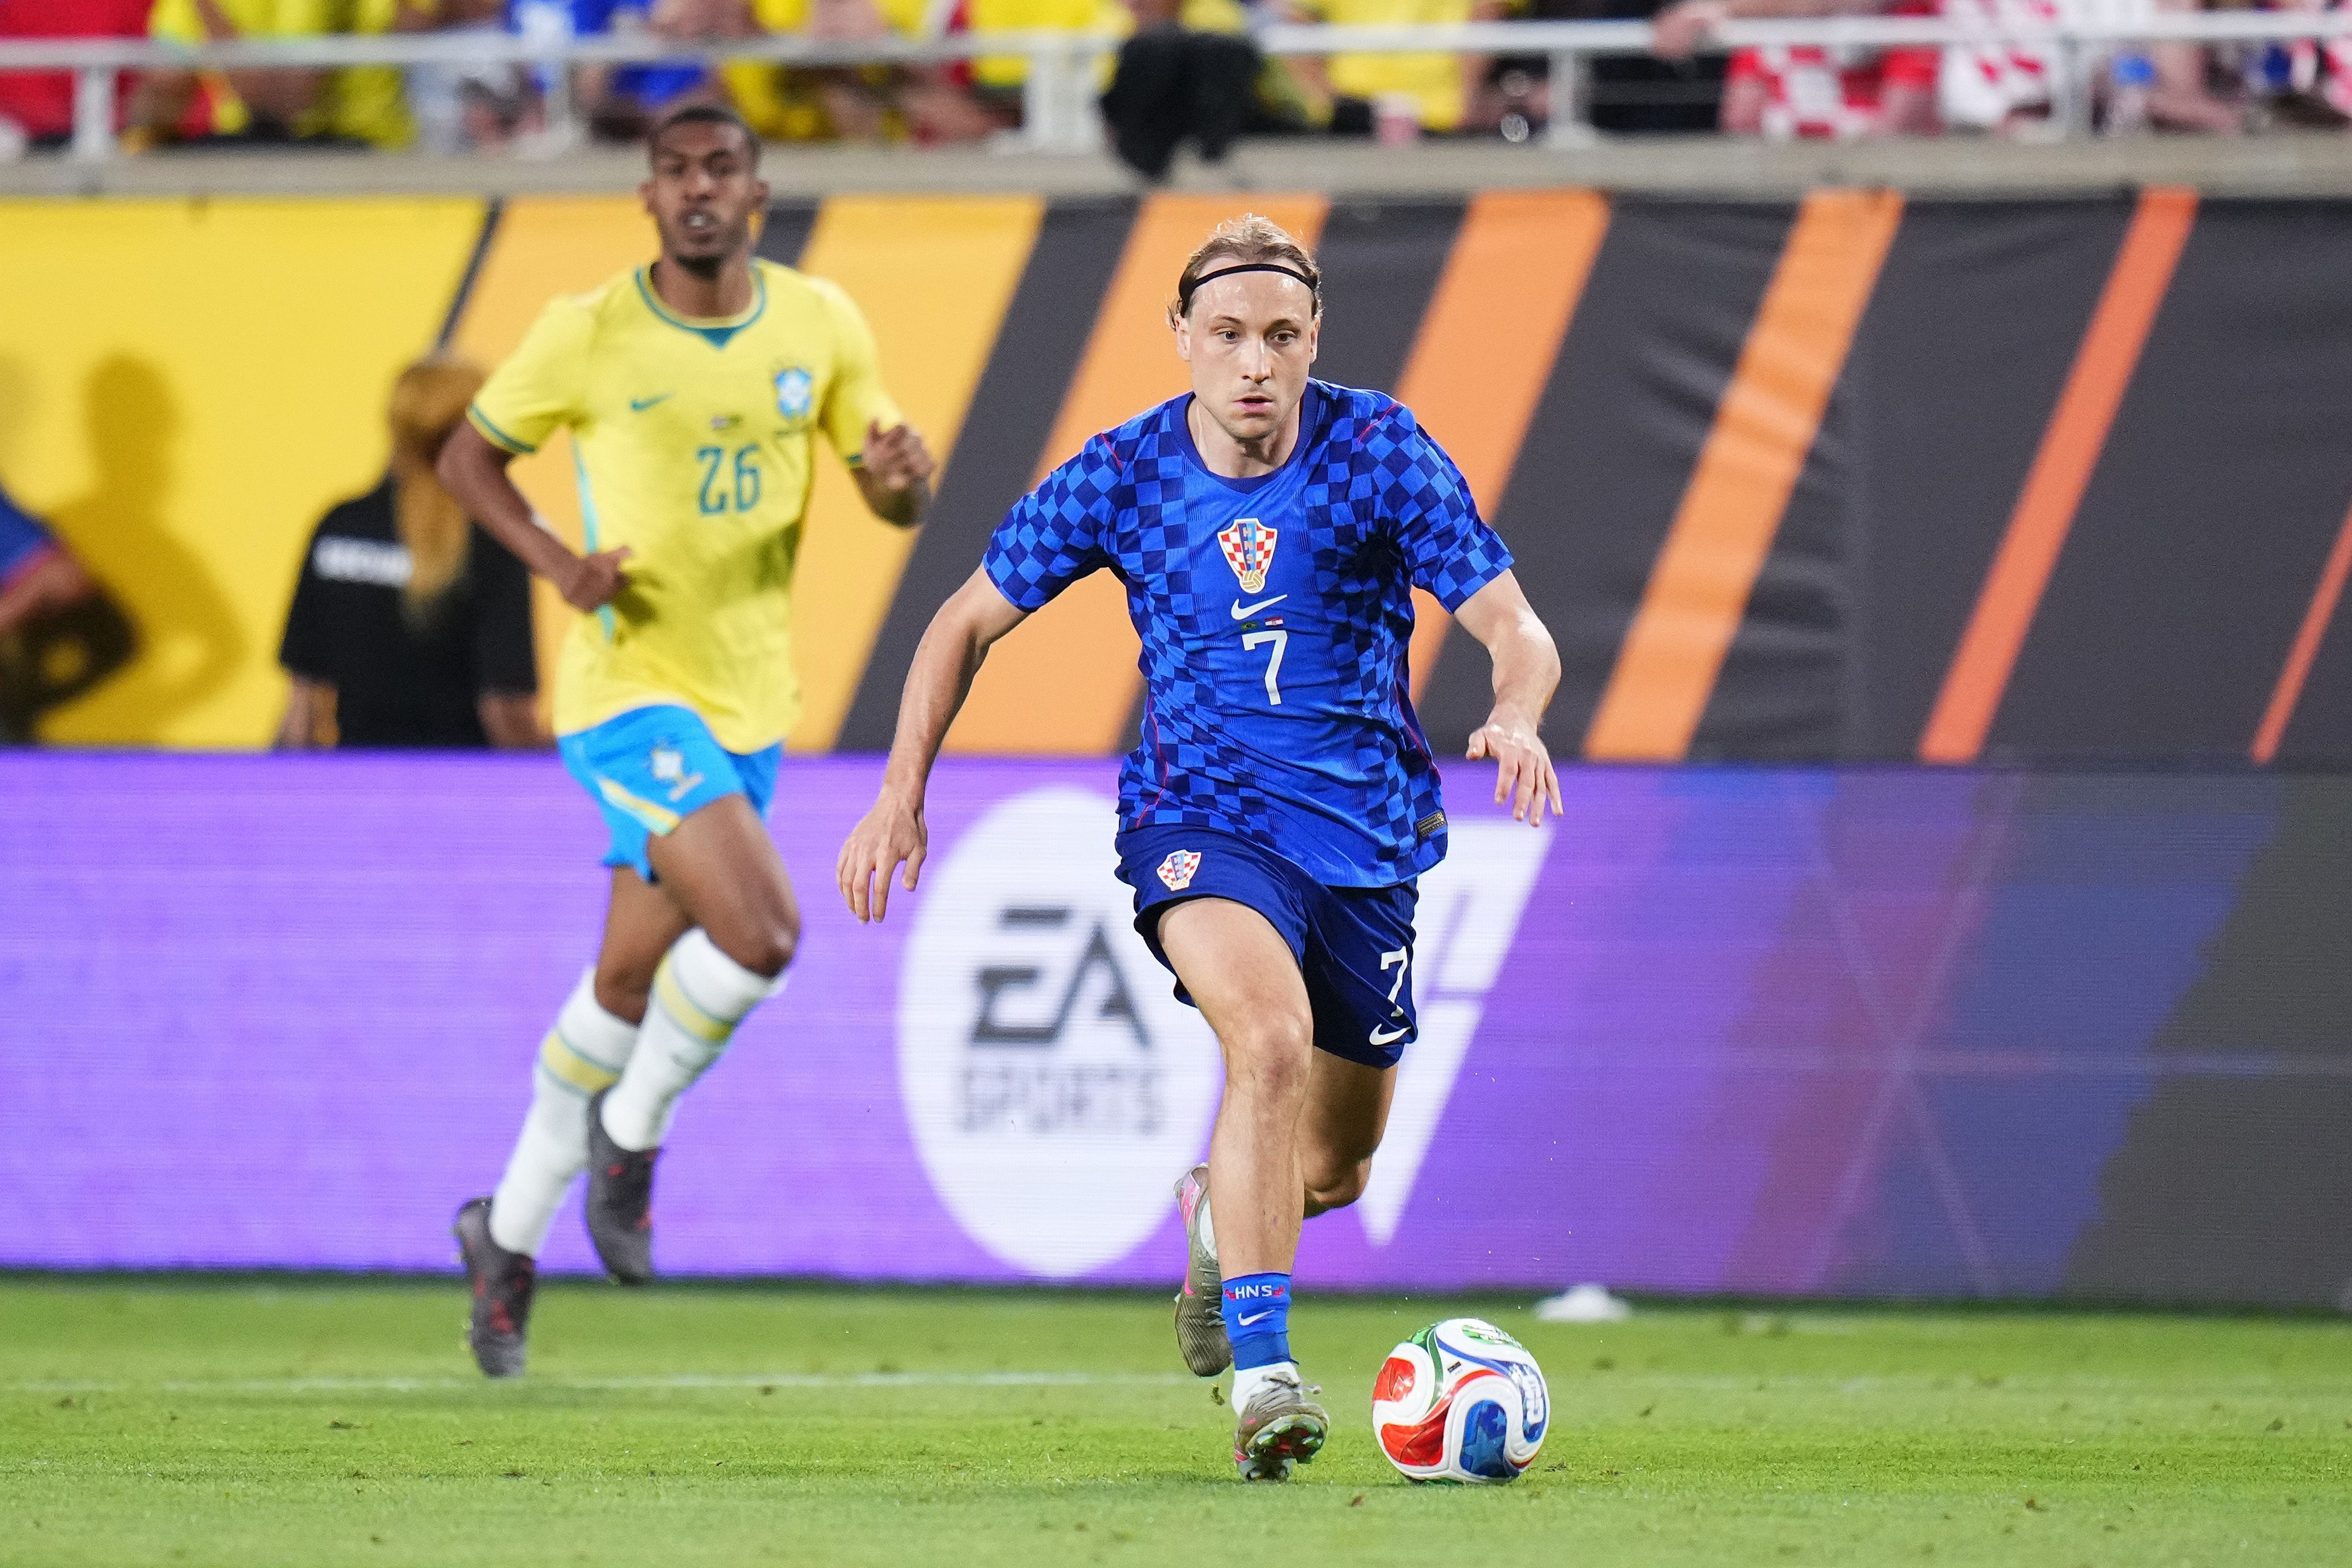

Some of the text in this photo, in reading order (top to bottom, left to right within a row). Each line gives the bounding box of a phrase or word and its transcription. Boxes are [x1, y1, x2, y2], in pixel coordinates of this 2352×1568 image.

[697, 445, 760, 514] 26
[1242, 630, 1288, 706] 7
[970, 906, 1152, 1046] EA
[1380, 945, 1408, 1017] 7
[1235, 1284, 1272, 1300] HNS
